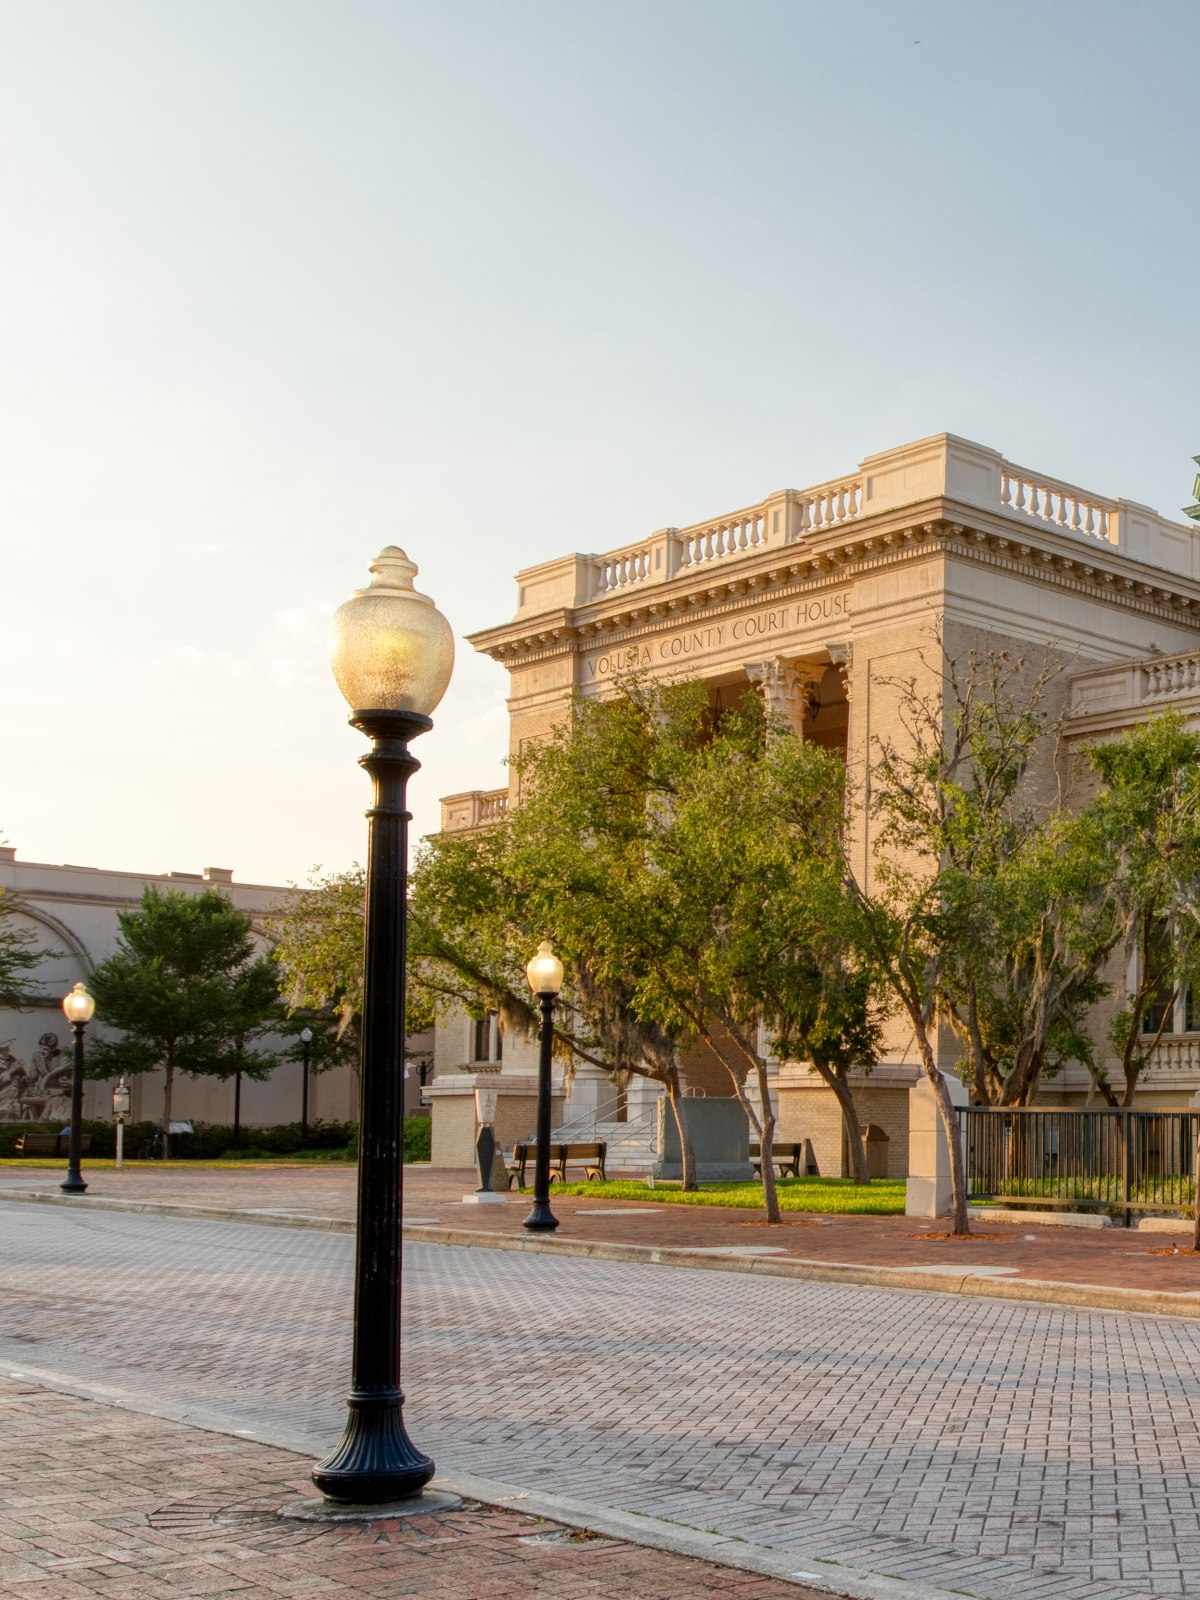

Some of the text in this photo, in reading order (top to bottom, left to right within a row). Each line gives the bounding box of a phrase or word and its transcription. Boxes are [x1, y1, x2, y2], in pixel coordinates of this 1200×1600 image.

[660, 626, 725, 658] COUNTY
[733, 609, 789, 639] COURT
[796, 593, 852, 624] HOUSE
